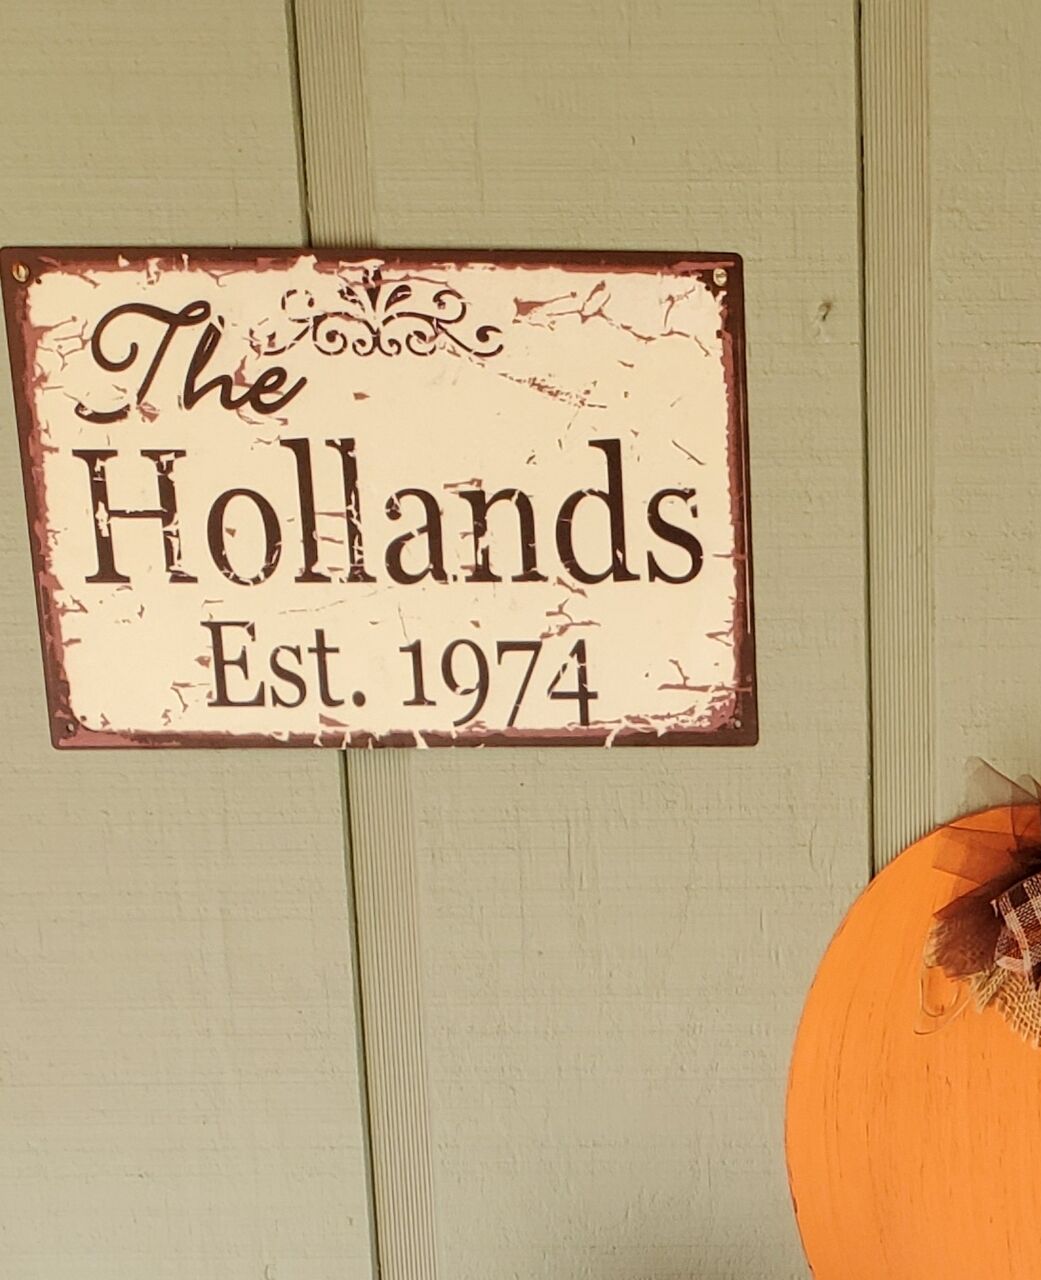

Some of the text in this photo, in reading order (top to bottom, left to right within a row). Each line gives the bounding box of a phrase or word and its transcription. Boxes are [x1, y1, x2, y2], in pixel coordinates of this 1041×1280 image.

[75, 301, 308, 424] The
[72, 437, 704, 586] Hollands
[200, 620, 599, 728] Est. 1974
